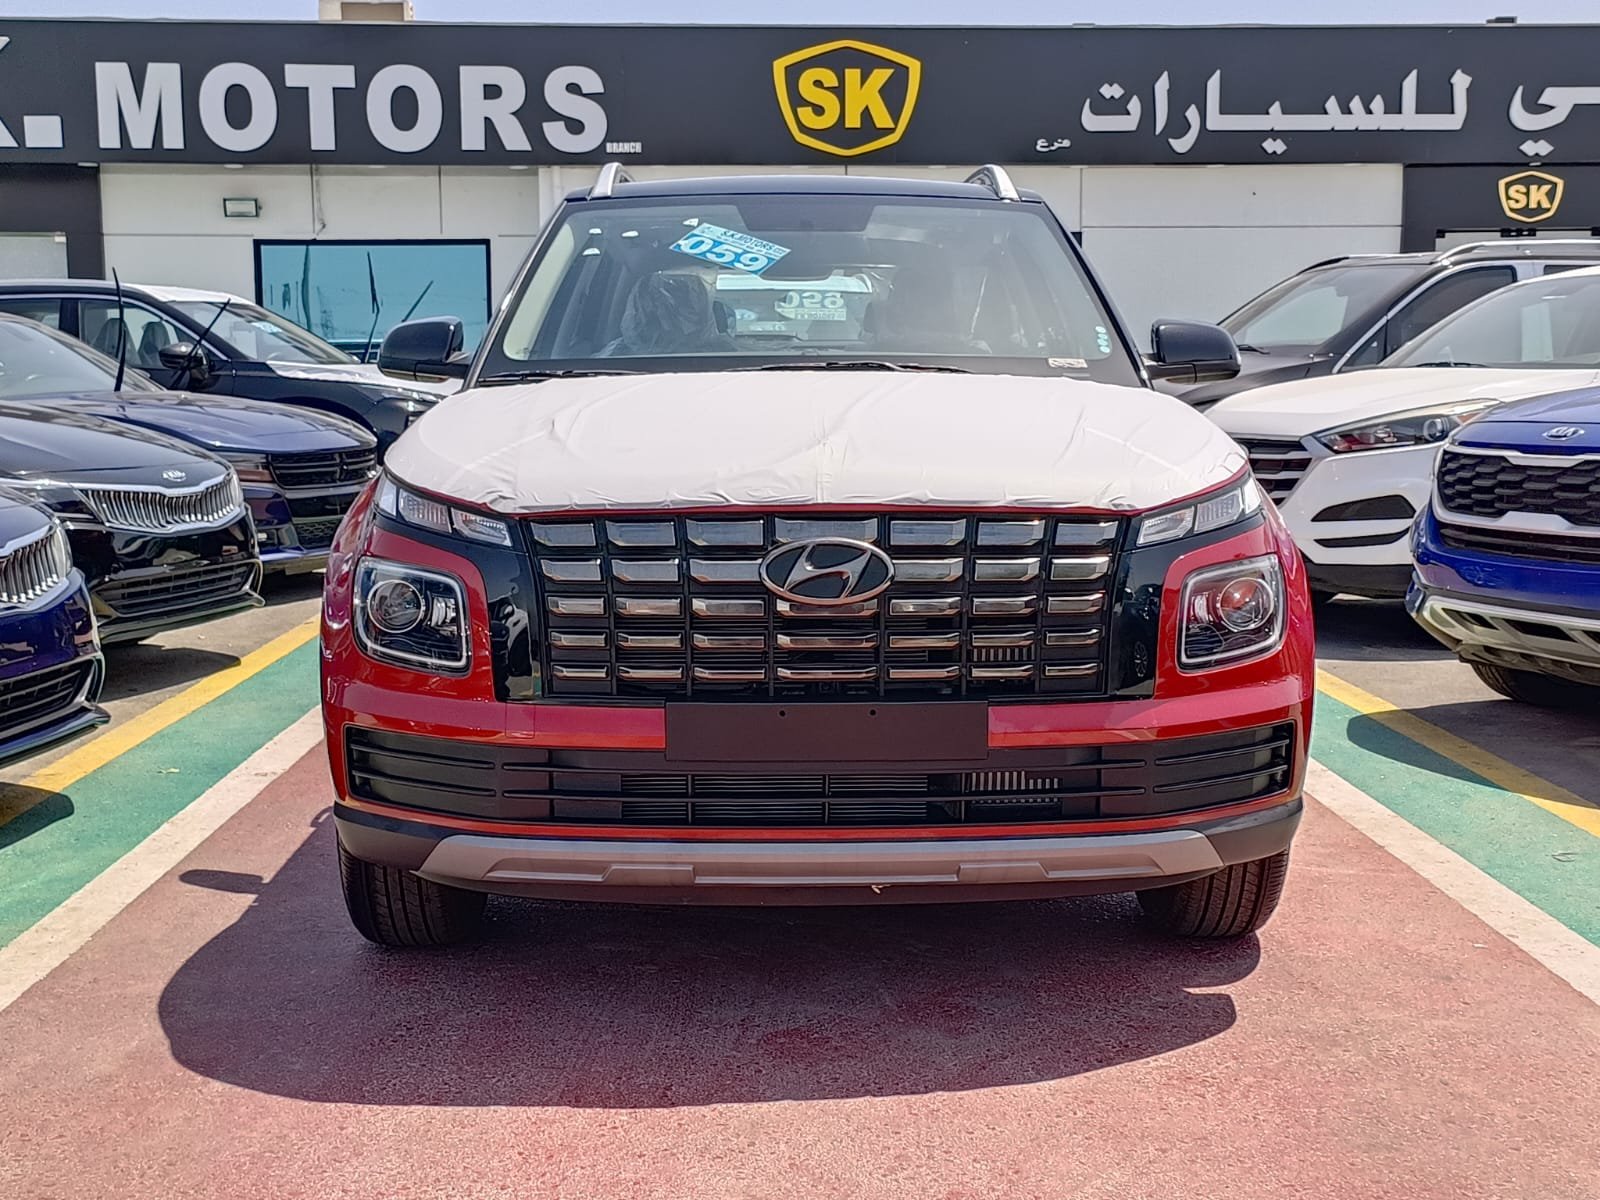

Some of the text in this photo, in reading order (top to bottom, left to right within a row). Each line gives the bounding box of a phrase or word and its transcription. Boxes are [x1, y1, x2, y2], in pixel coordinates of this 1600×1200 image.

[95, 61, 608, 153] MOTORS
[797, 67, 896, 129] SK
[1080, 69, 1472, 154] للسيارات
[606, 142, 642, 153] BRANCH
[1507, 184, 1552, 209] SK
[679, 236, 769, 271] 059
